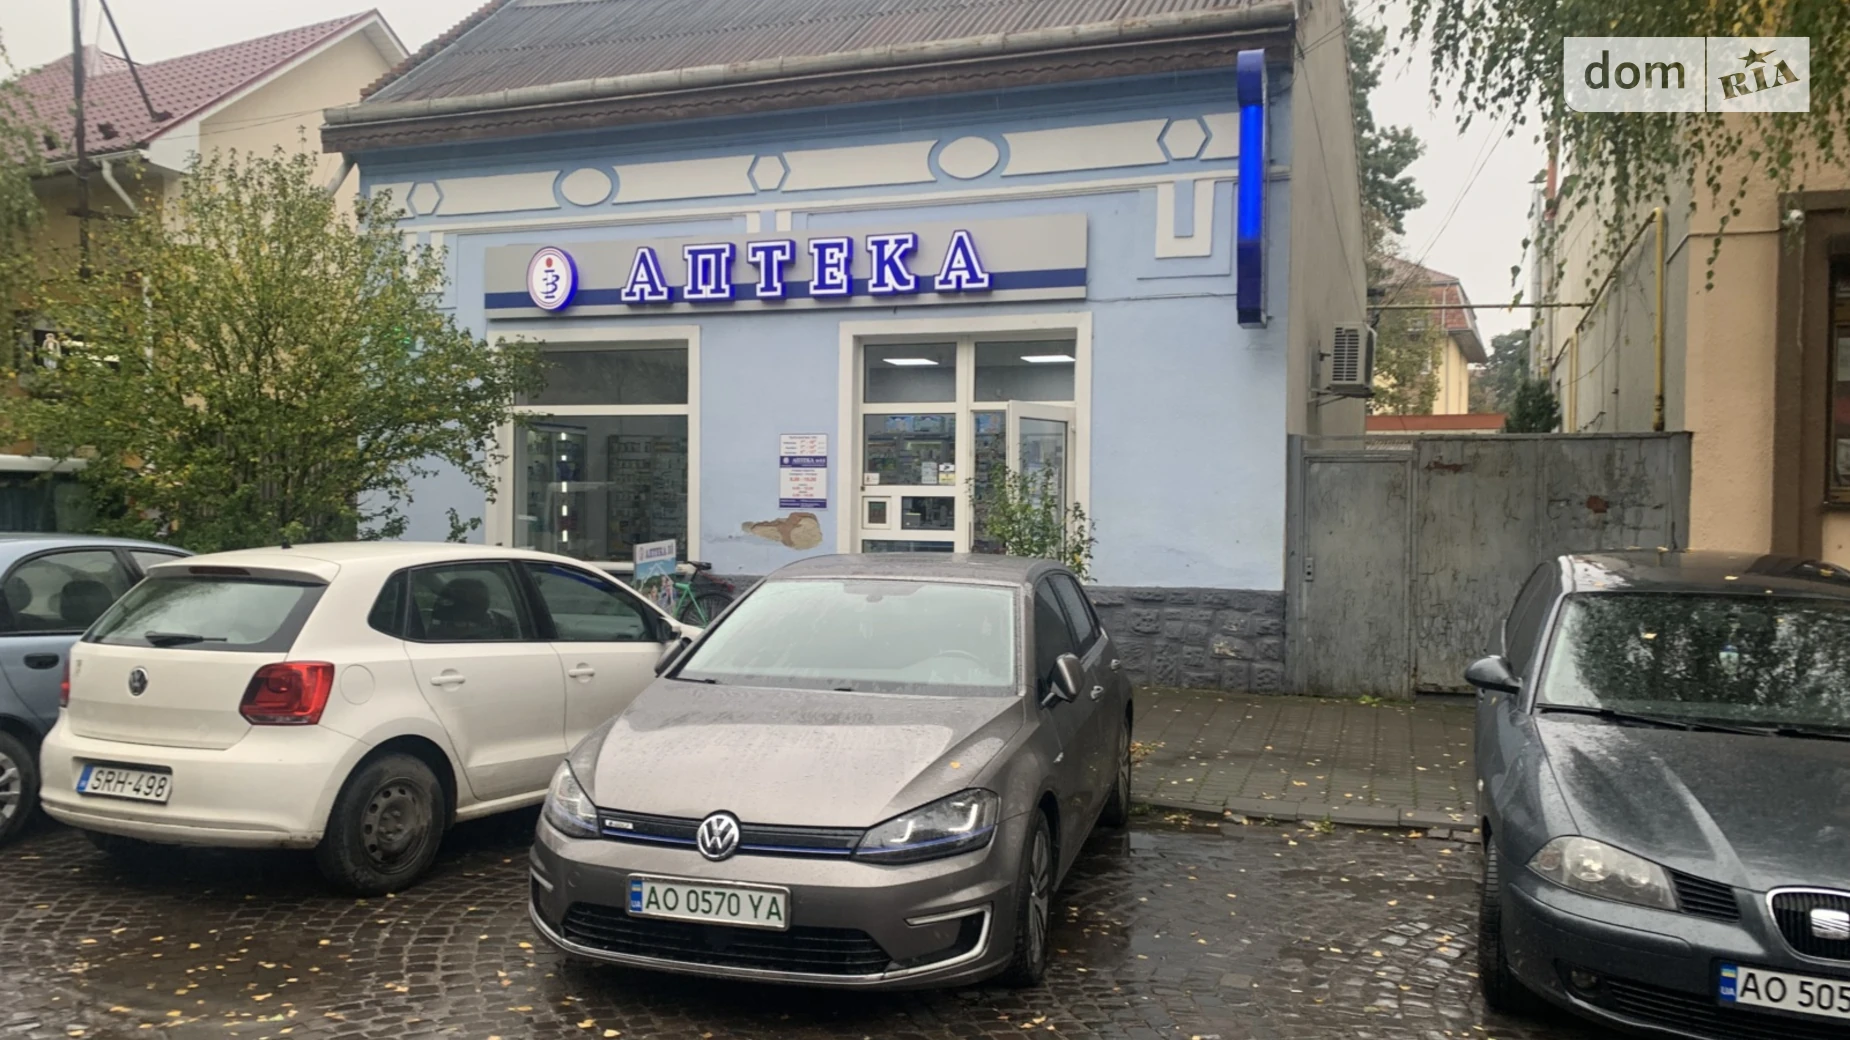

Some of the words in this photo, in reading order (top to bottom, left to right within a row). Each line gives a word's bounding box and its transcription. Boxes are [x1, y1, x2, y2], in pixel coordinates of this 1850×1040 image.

[620, 229, 992, 302] АПТЕКА
[91, 769, 168, 798] SRH-498
[645, 886, 679, 911] AO
[686, 889, 741, 917] 0570
[748, 894, 783, 921] YA
[1739, 972, 1788, 1003] AO
